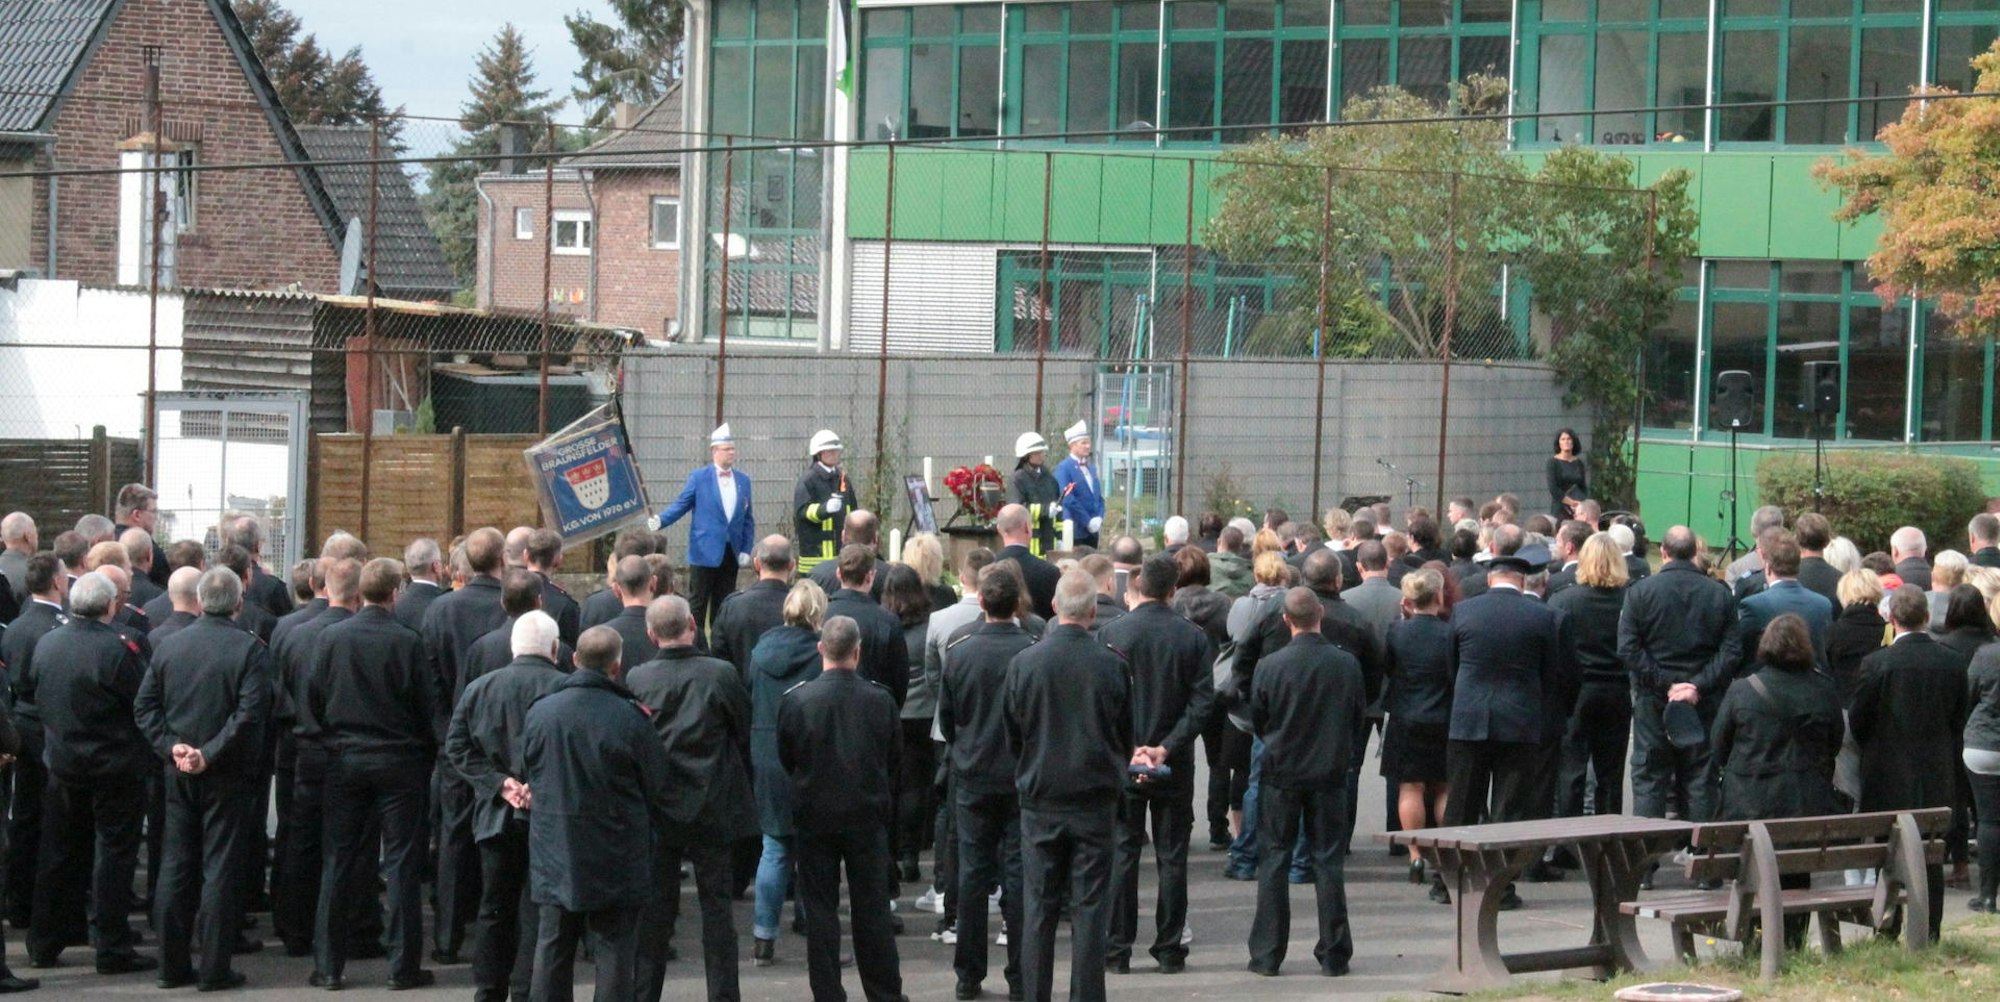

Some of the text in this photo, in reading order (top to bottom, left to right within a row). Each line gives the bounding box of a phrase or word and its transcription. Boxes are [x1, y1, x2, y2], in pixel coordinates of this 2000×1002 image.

[541, 437, 618, 471] BRAUNSFELDER
[558, 437, 597, 456] GROSSE
[579, 510, 601, 525] VON
